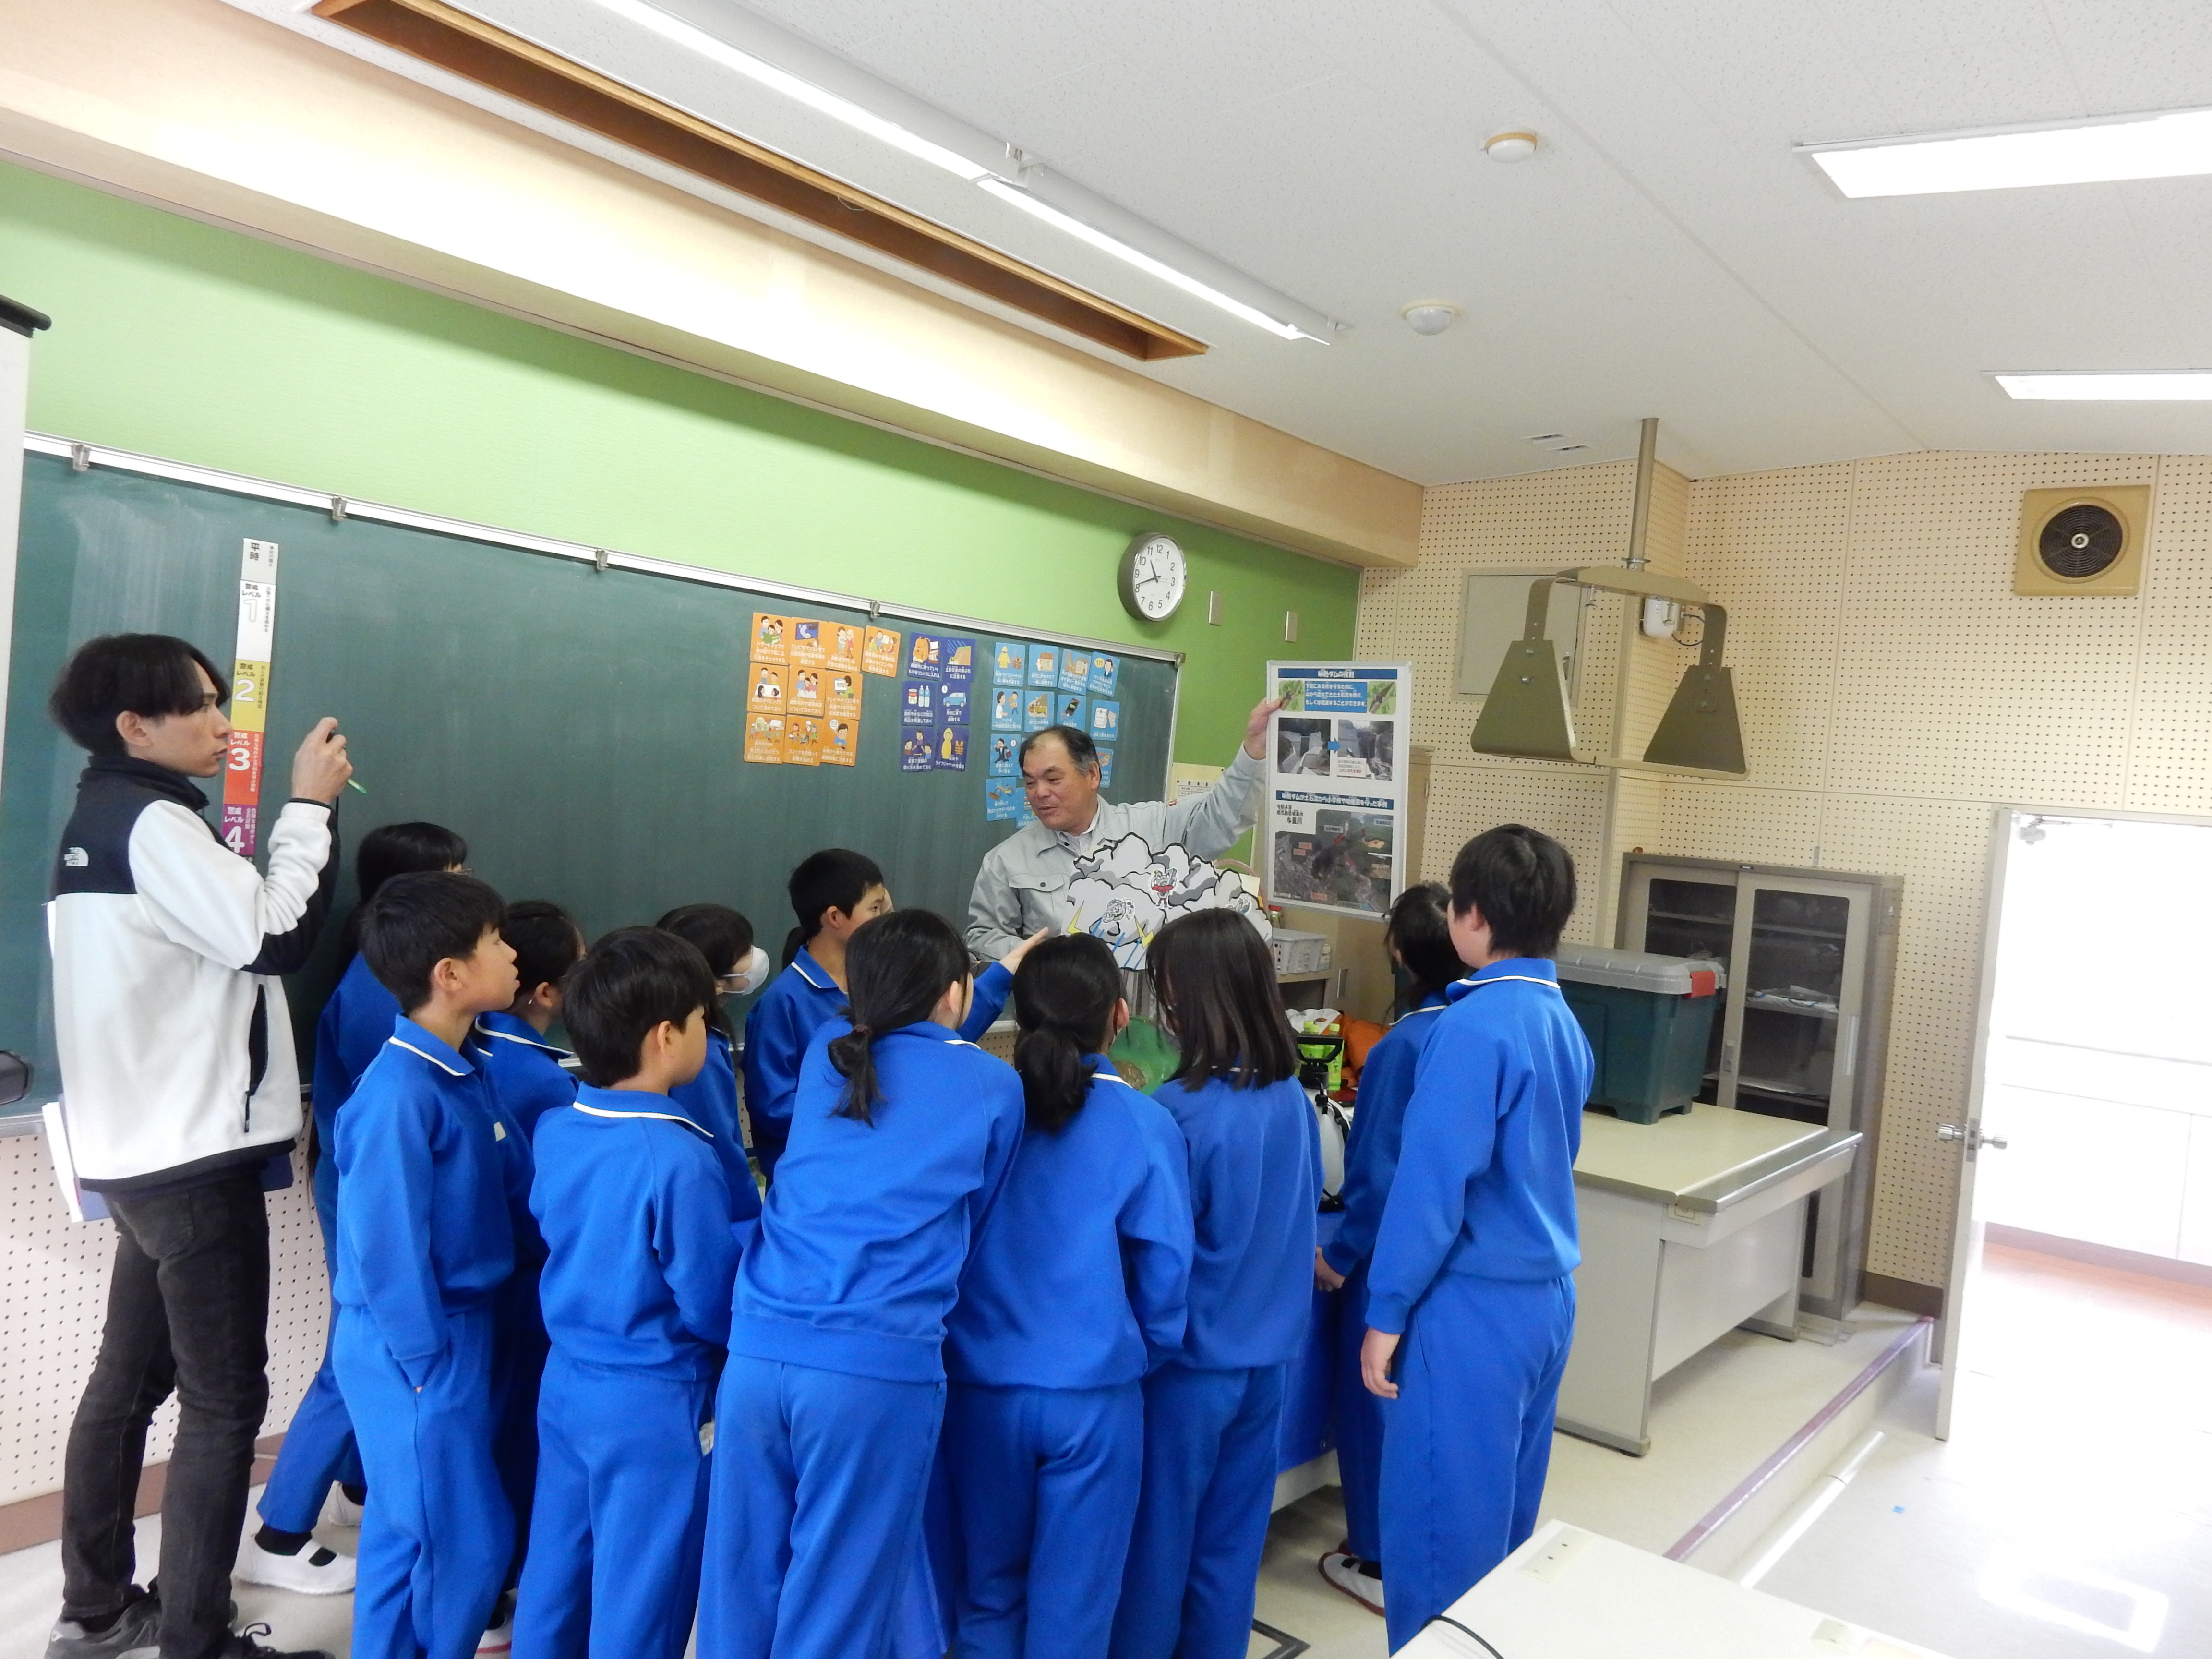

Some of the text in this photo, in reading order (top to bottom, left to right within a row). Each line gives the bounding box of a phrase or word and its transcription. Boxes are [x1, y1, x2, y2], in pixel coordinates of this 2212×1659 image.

[250, 542, 260, 561] 平時
[1148, 546, 1153, 556] 11
[1156, 544, 1163, 553] 12
[1166, 551, 1169, 559] 1
[1139, 556, 1146, 565] 10
[1170, 562, 1175, 571] 2
[1135, 569, 1140, 578] 9
[1171, 577, 1175, 586] 3
[1135, 584, 1140, 592] 8
[1166, 591, 1170, 600] 4
[1141, 597, 1145, 605] 7
[1148, 601, 1153, 610] 6
[1158, 600, 1162, 608] 5
[243, 598, 257, 622] 1
[235, 679, 255, 702] 2
[229, 747, 250, 771] 3
[225, 826, 245, 853] 4
